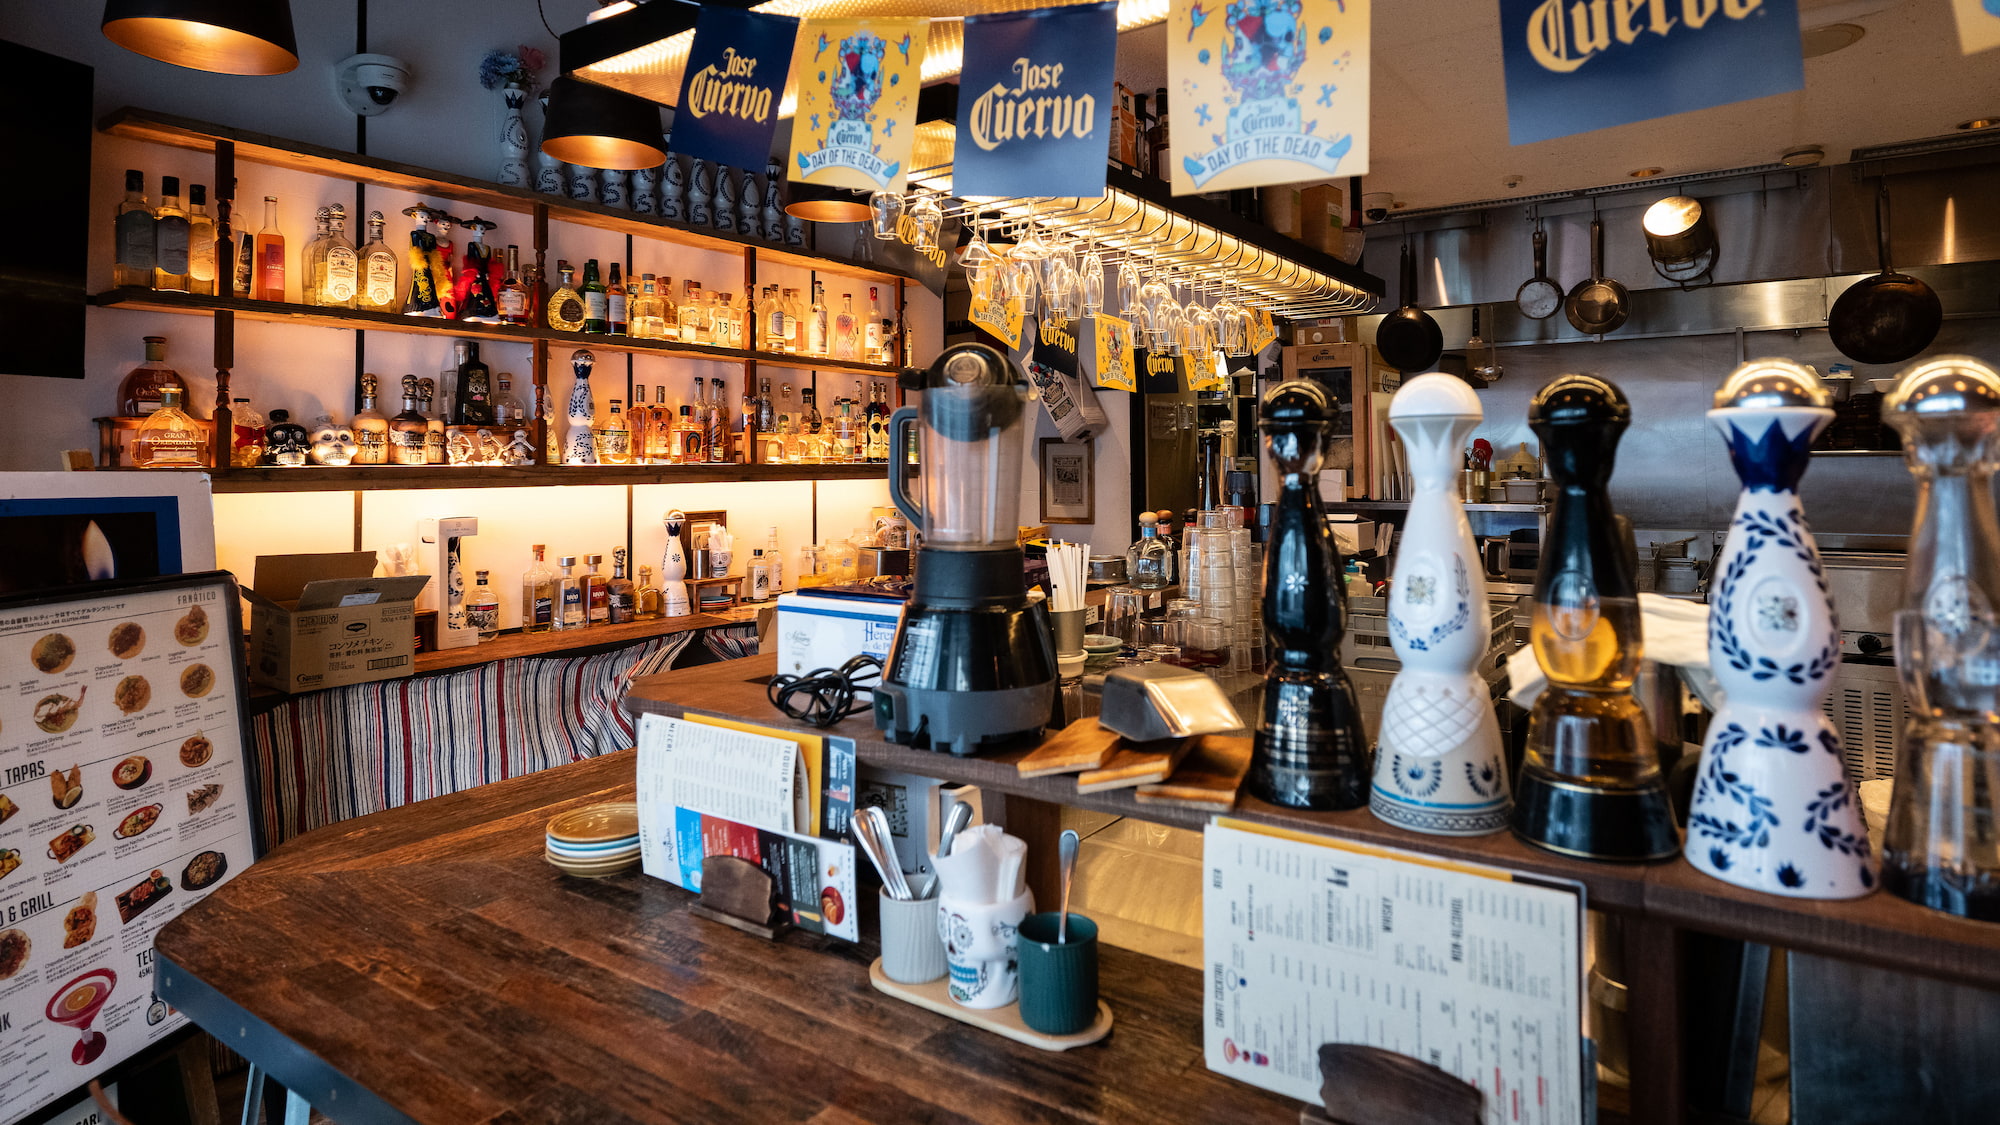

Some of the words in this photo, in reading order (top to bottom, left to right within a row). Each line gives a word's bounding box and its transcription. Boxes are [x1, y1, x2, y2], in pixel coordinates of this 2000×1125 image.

[721, 46, 757, 80] Jose
[1011, 57, 1064, 98] Jose
[688, 63, 774, 124] Cuervo
[970, 82, 1096, 151] Cuervo
[811, 151, 827, 168] DAY
[829, 149, 839, 163] OF
[842, 149, 857, 165] THE
[858, 152, 882, 175] DEAD
[1207, 150, 1231, 172] DAY
[1234, 140, 1250, 161] OF
[1255, 135, 1280, 156] THE
[1285, 136, 1322, 159] DEAD
[5, 760, 45, 785] TAPAS
[781, 745, 793, 783] TEQUILA
[8, 905, 16, 922] &
[21, 891, 55, 918] GRILL
[1381, 896, 1393, 933] WHISKY
